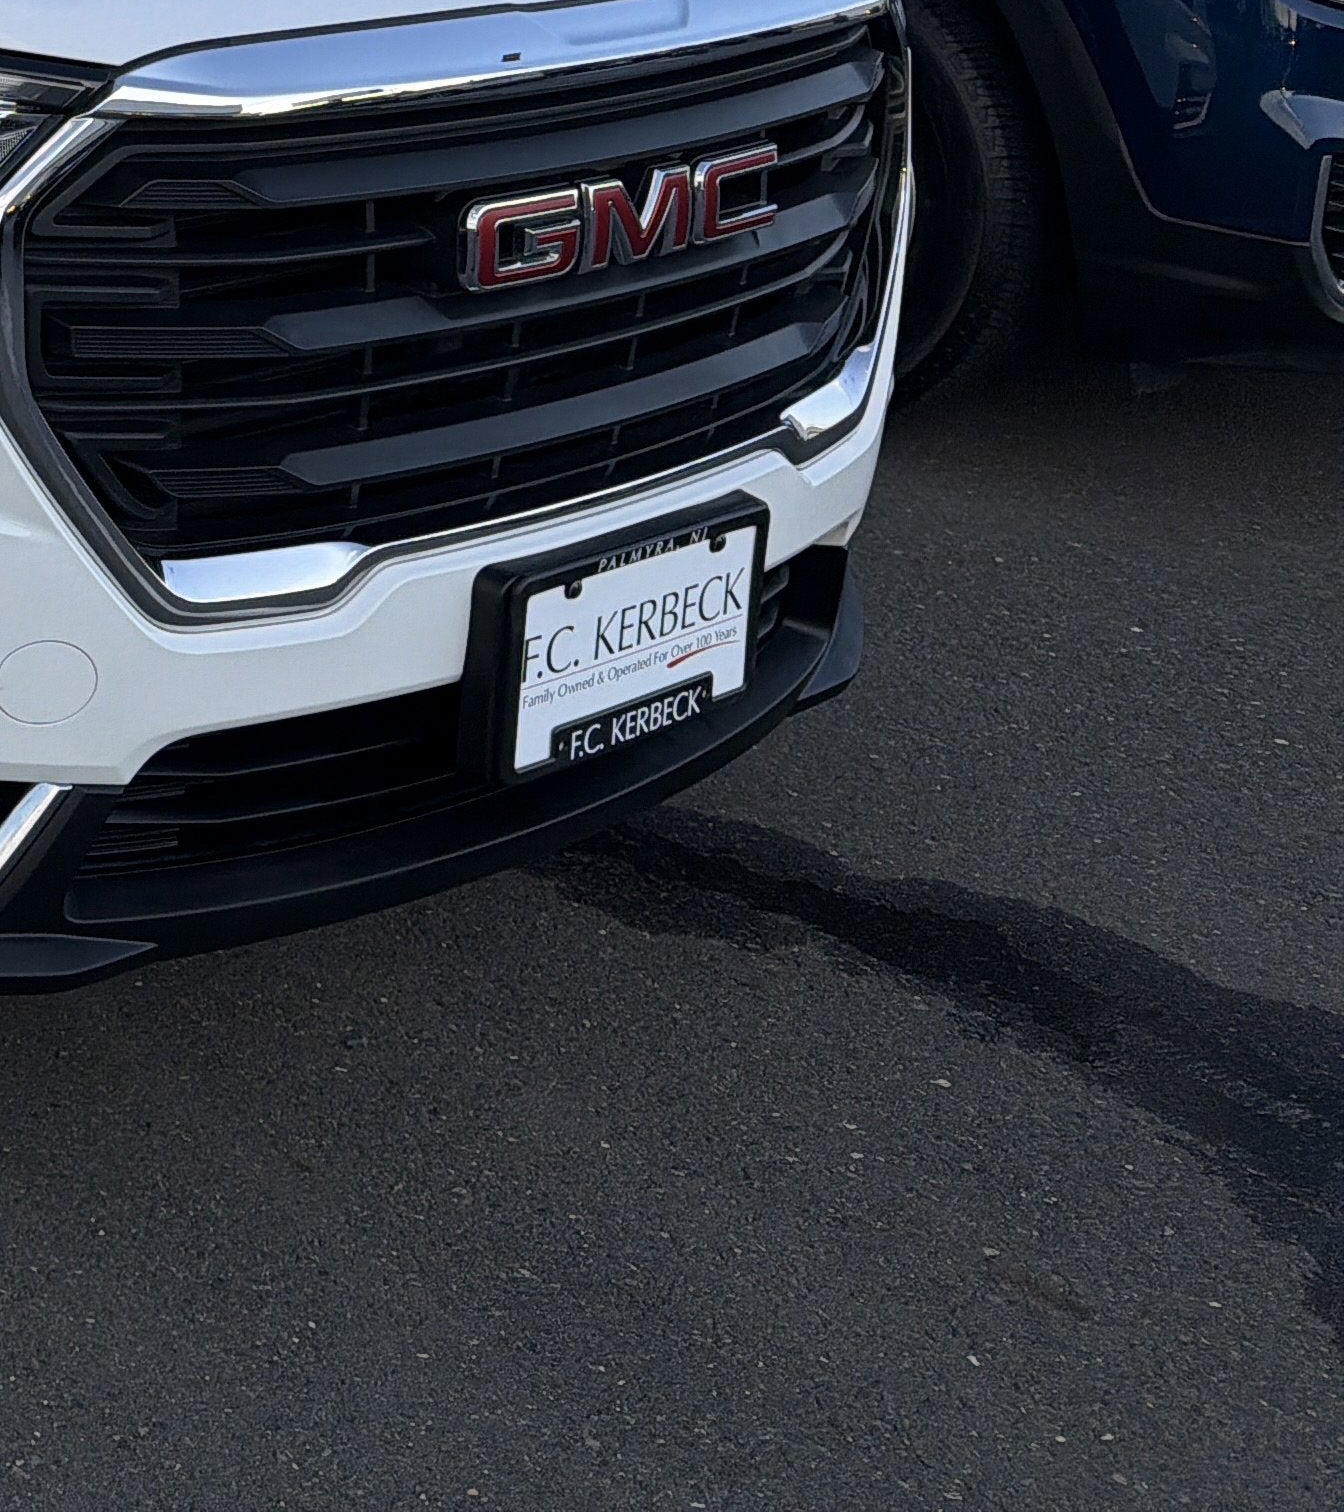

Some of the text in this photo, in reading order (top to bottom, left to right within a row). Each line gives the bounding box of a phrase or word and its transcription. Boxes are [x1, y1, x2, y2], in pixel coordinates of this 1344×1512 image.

[465, 140, 779, 292] GMC
[597, 540, 681, 573] PALMYRA,
[521, 566, 746, 684] F.C. KERBECK
[522, 626, 738, 710] Family Owned & Operated For Over 100 Years
[569, 685, 703, 761] F.C. KERBECK
